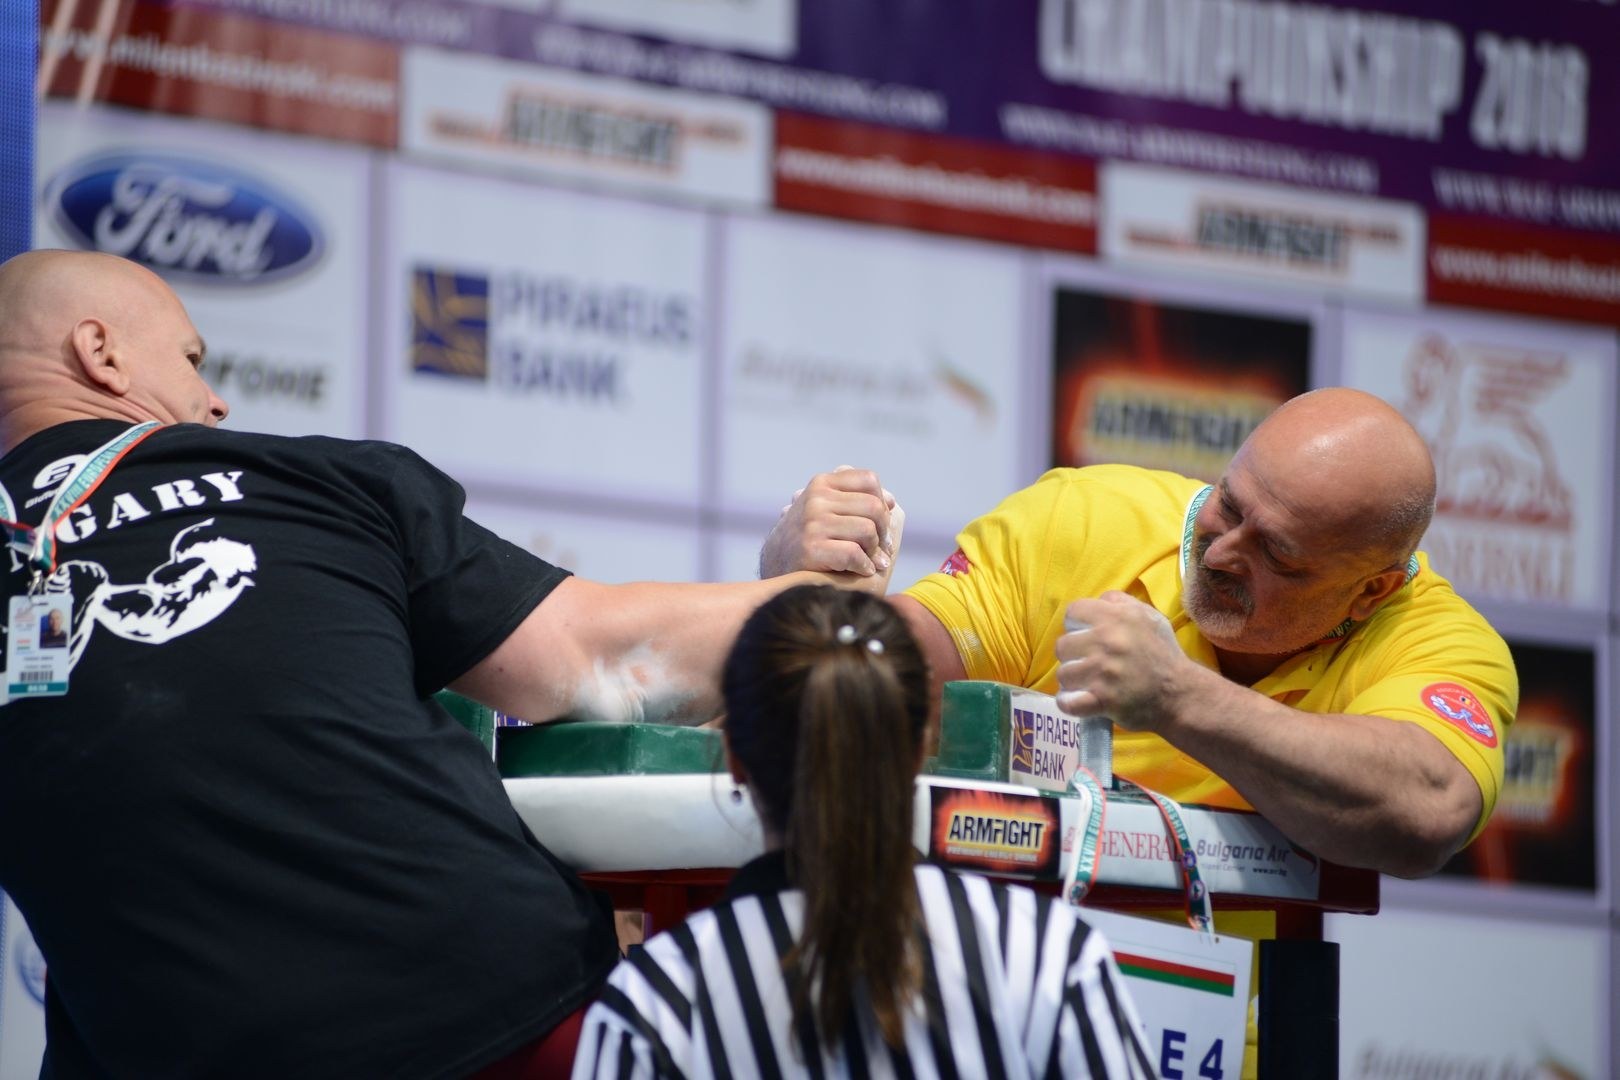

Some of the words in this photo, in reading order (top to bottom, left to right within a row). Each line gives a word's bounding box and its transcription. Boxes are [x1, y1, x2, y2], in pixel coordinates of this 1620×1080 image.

[1039, 0, 1464, 141] CHAMPIONSHIP
[93, 162, 280, 281] Ford
[501, 272, 693, 345] PIRAEUS
[505, 343, 624, 405] BANK
[1094, 398, 1260, 453] ARMFIGH
[1036, 713, 1080, 749] PIRAEUS
[1034, 749, 1066, 781] BANK
[949, 815, 1044, 849] ARMFIGHT
[1196, 839, 1264, 862] Bulgaria
[1266, 844, 1290, 862] Air
[1160, 1028, 1187, 1080] E
[1198, 1038, 1224, 1080] 4
